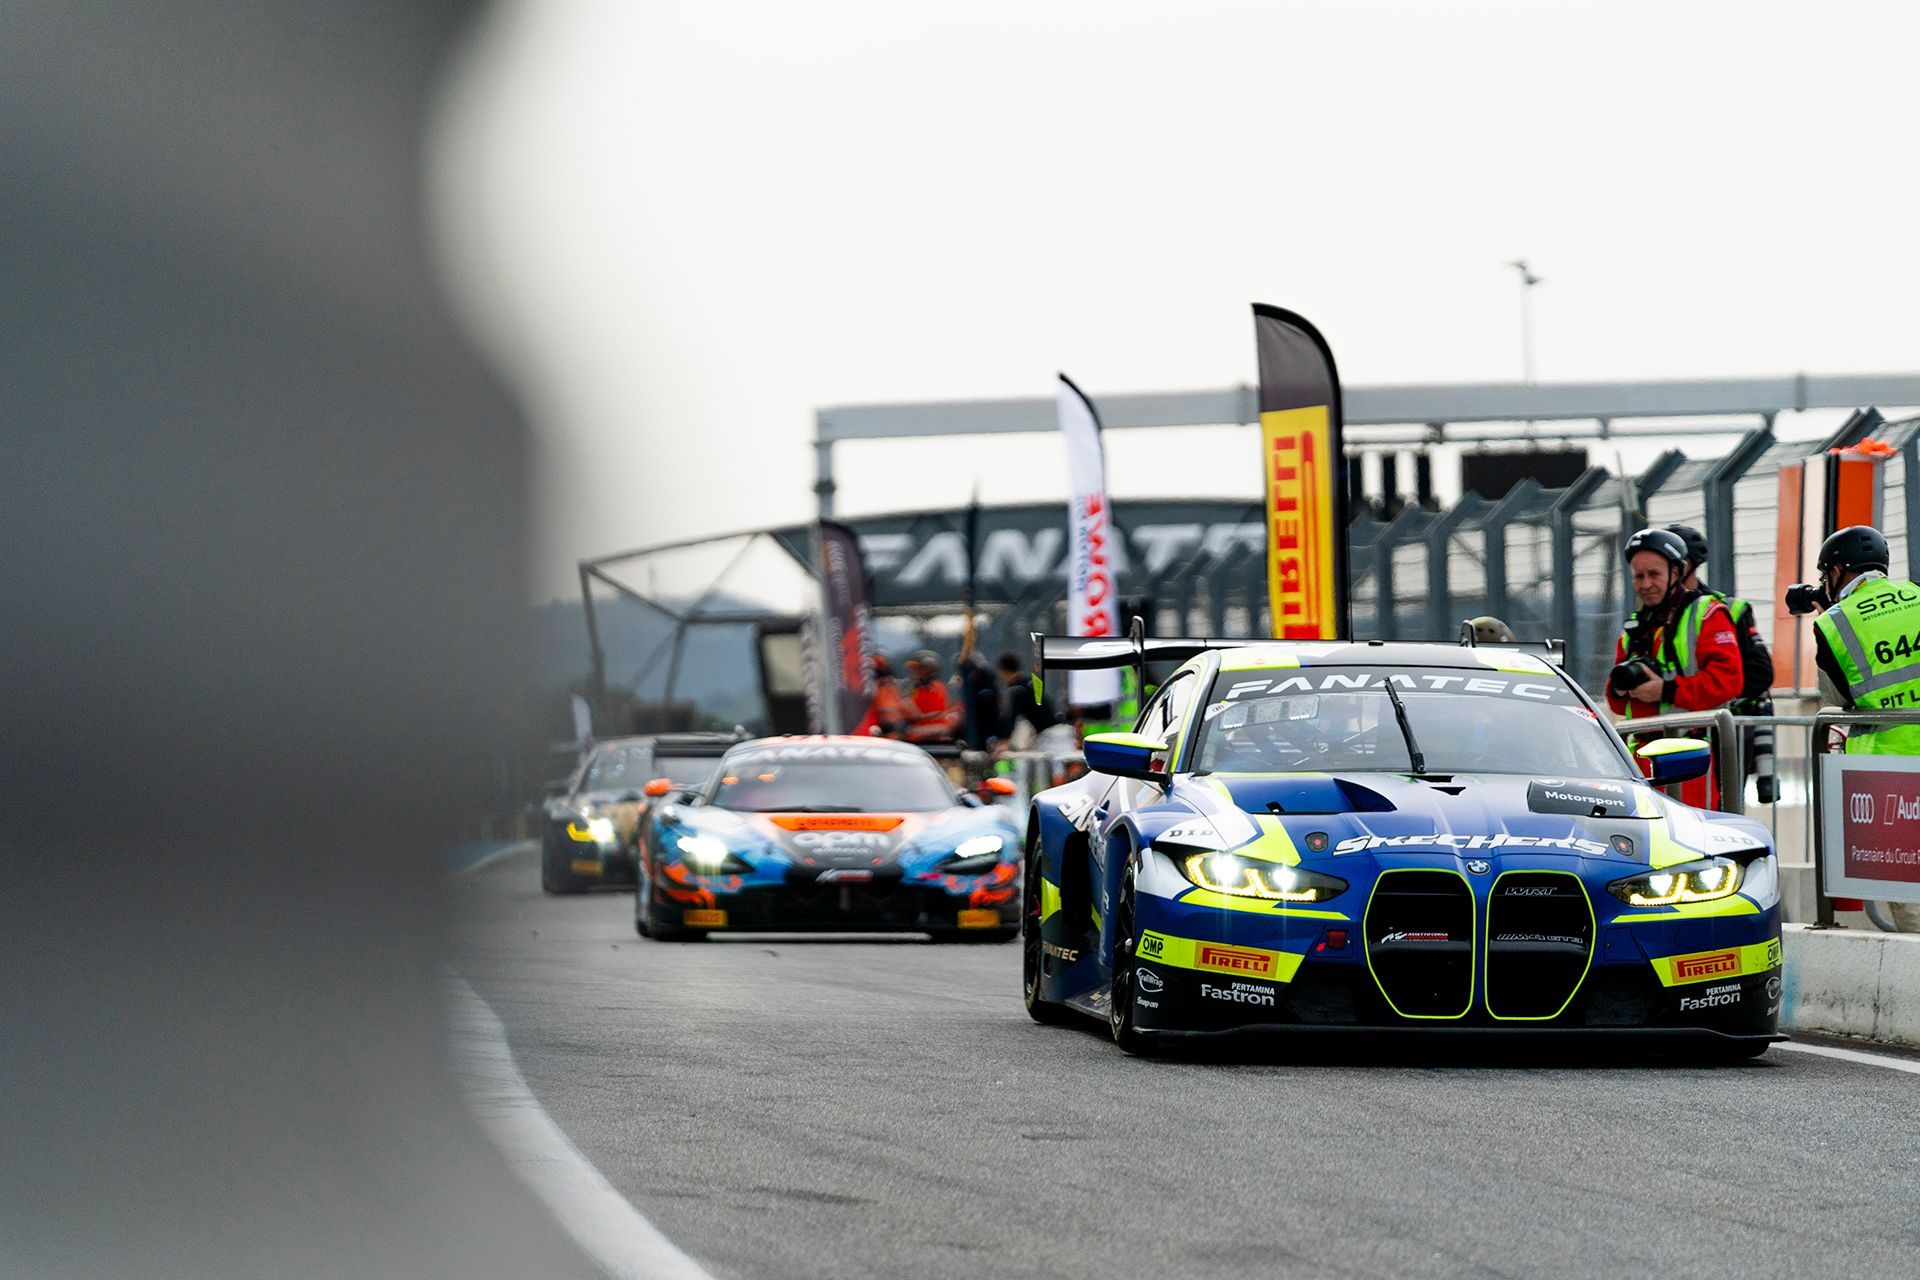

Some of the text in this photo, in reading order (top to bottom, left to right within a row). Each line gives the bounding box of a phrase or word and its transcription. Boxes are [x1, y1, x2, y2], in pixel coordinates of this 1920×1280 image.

[1225, 674, 1559, 700] FANATEC
[1880, 692, 1905, 708] PIT
[1544, 790, 1626, 807] Motorsport
[1332, 833, 1609, 856] SKECHERS
[1852, 846, 1884, 863] Partenaire
[1885, 848, 1894, 864] du
[1895, 848, 1917, 865] Circuit
[1143, 937, 1164, 954] OMP
[1202, 947, 1271, 972] PIRELLI
[1676, 953, 1736, 978] PIRELLI
[1201, 983, 1275, 1007] Fastron
[1231, 982, 1275, 996] PERTAMINA
[1706, 983, 1742, 996] PERTAMINA
[1680, 991, 1741, 1012] Fastron
